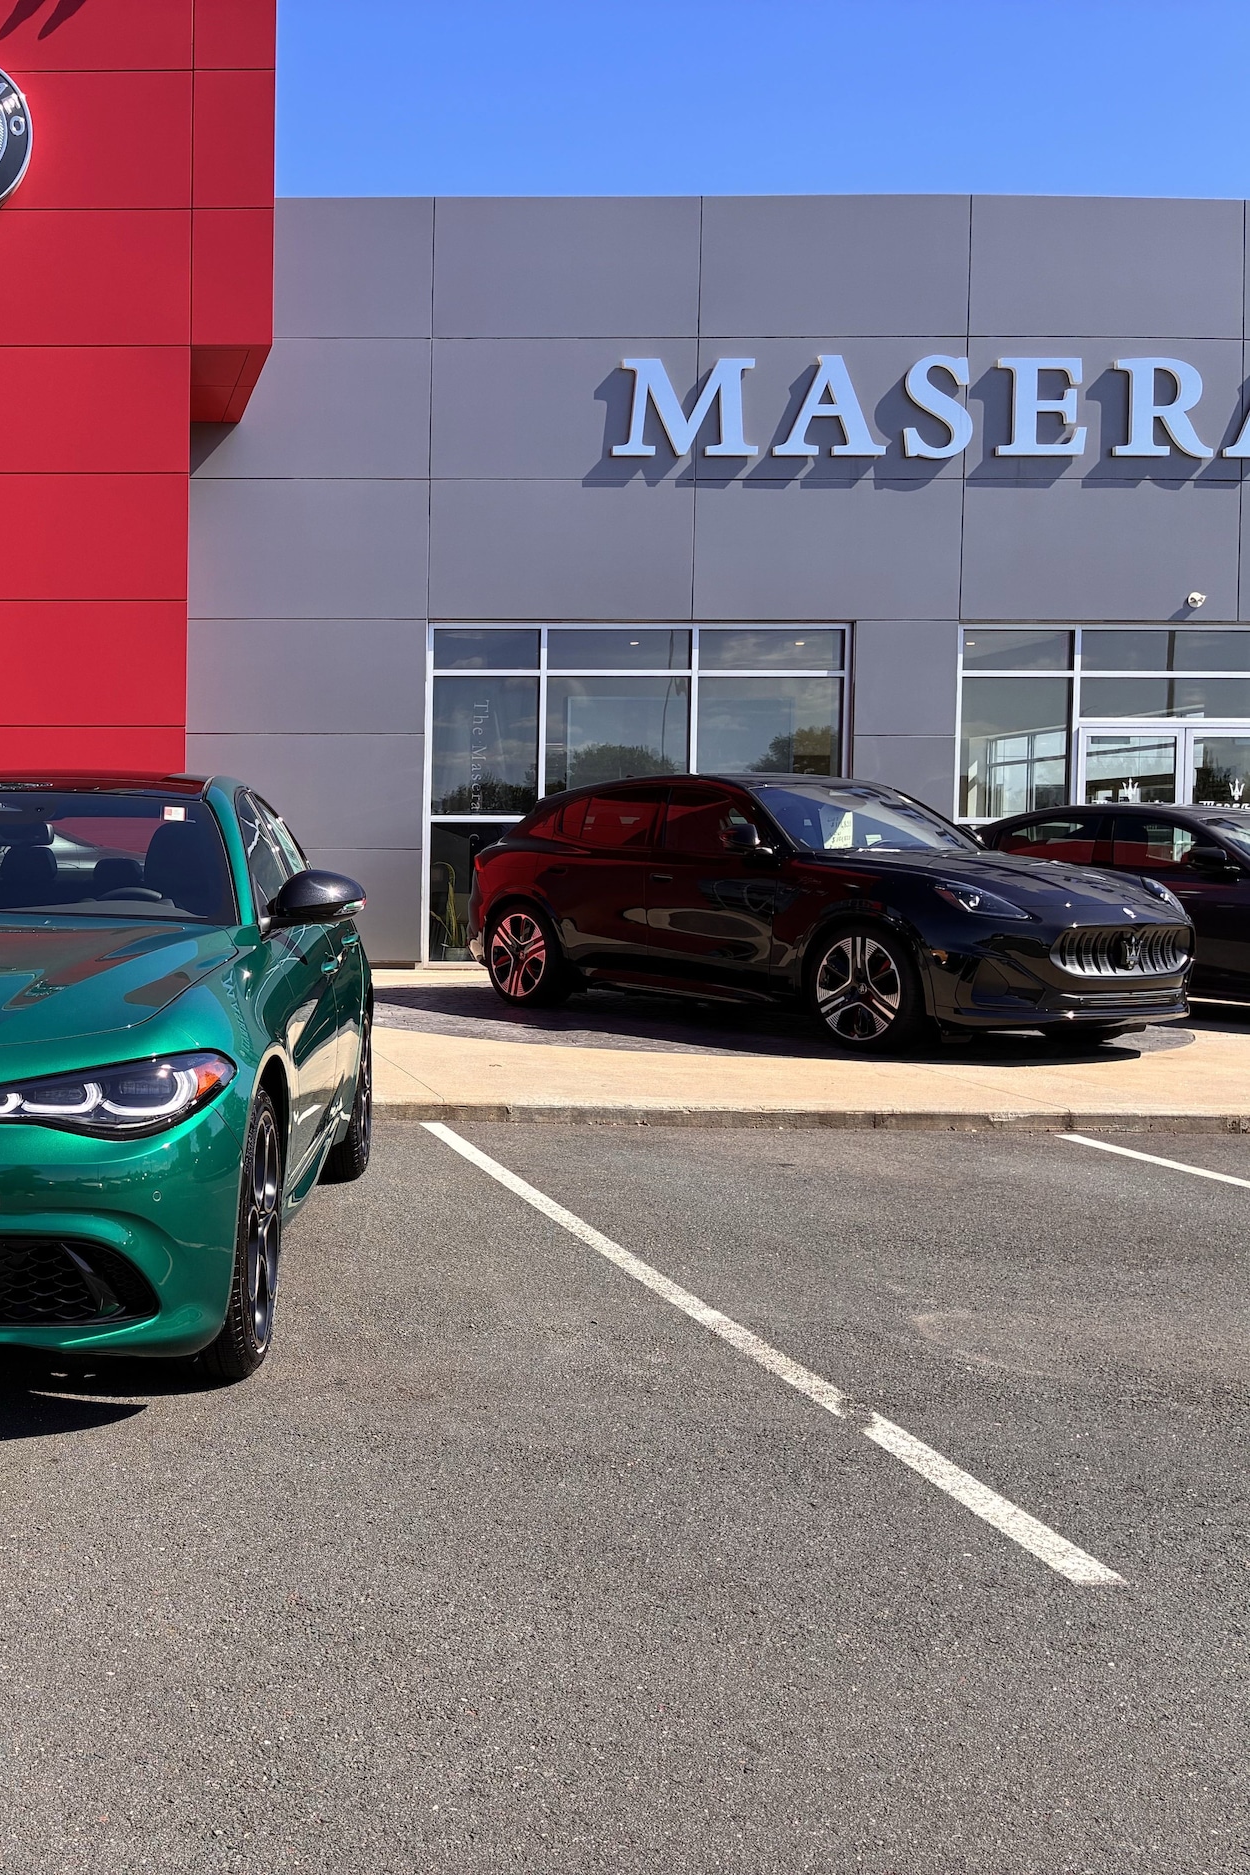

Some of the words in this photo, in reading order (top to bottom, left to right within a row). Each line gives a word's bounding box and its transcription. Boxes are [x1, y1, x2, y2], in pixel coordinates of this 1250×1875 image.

[611, 354, 1250, 460] MASER
[472, 700, 490, 736] The
[471, 745, 487, 815] Masera
